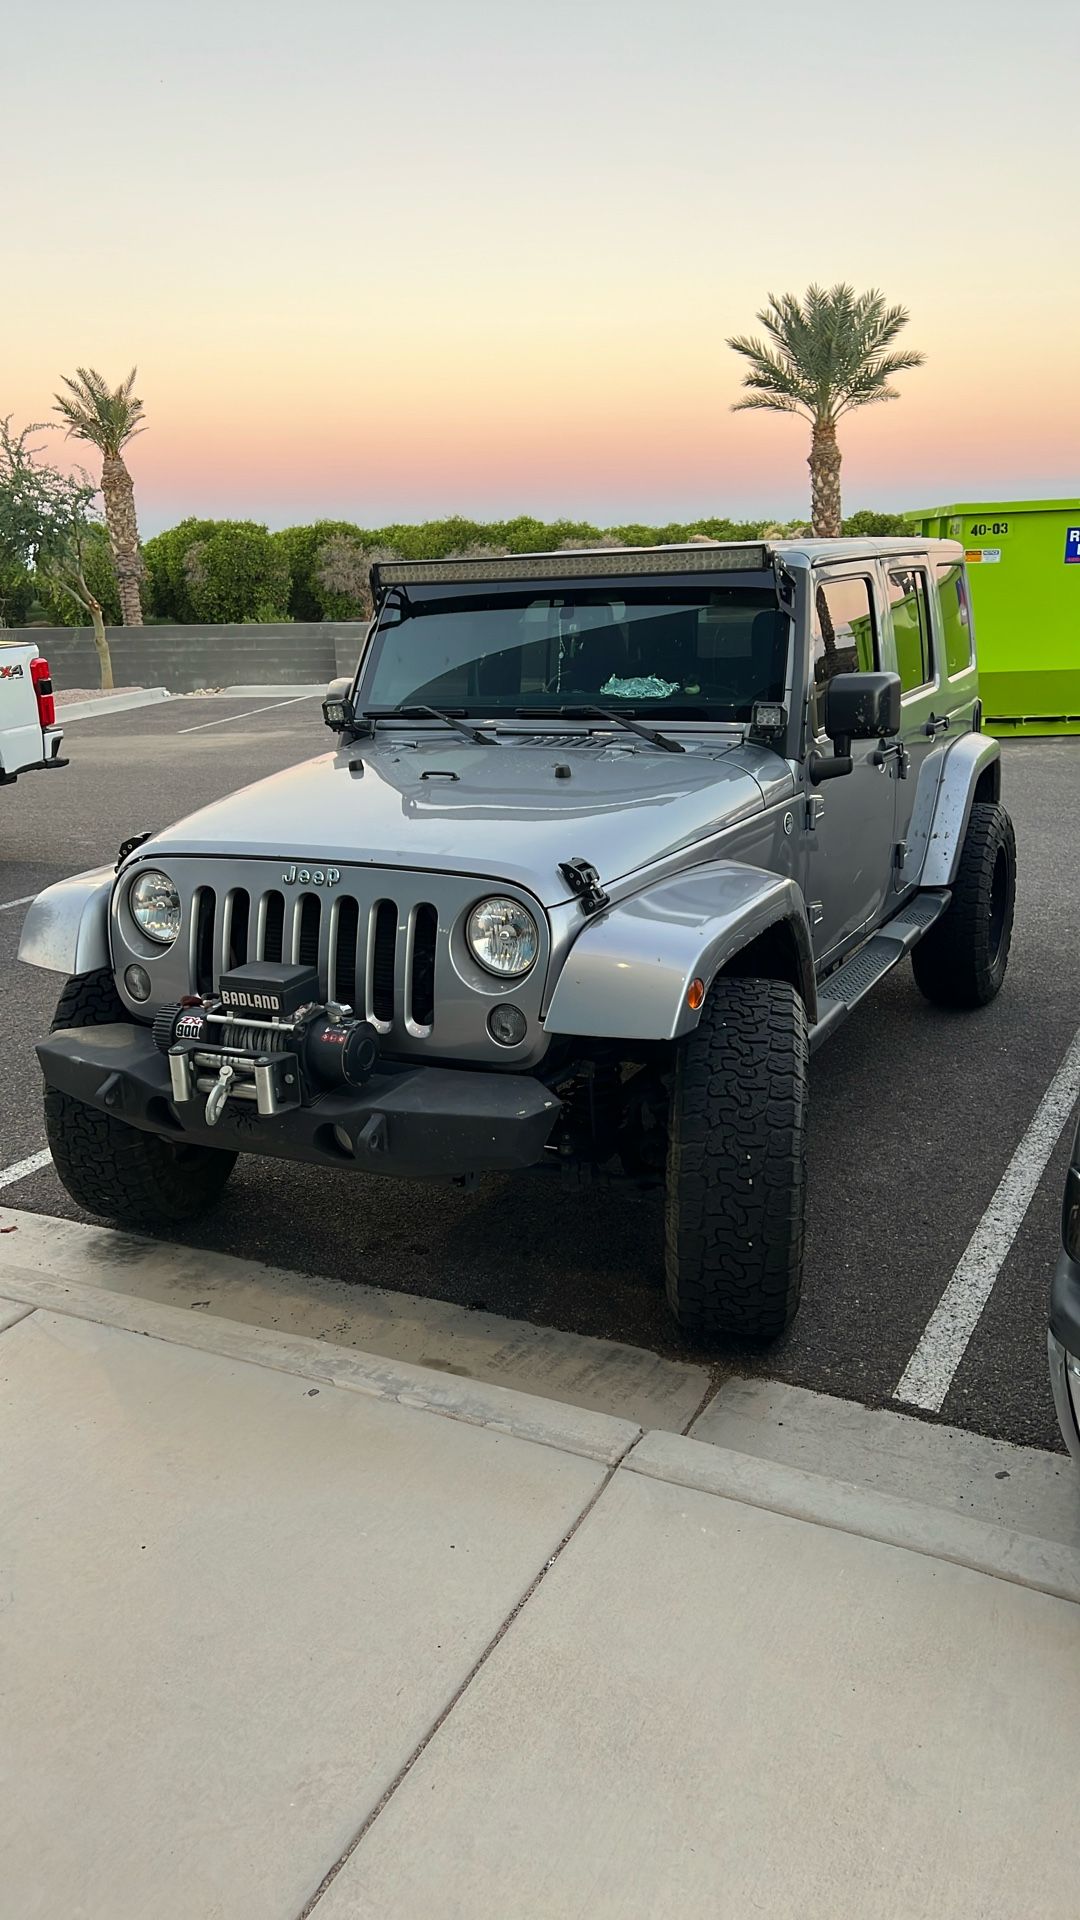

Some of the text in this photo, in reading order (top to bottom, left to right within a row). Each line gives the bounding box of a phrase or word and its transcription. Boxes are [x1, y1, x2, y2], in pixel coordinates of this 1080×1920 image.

[971, 523, 1008, 536] 40-03
[282, 865, 340, 887] Jeep
[221, 990, 279, 1010] BADLAND
[176, 1024, 201, 1038] 900
